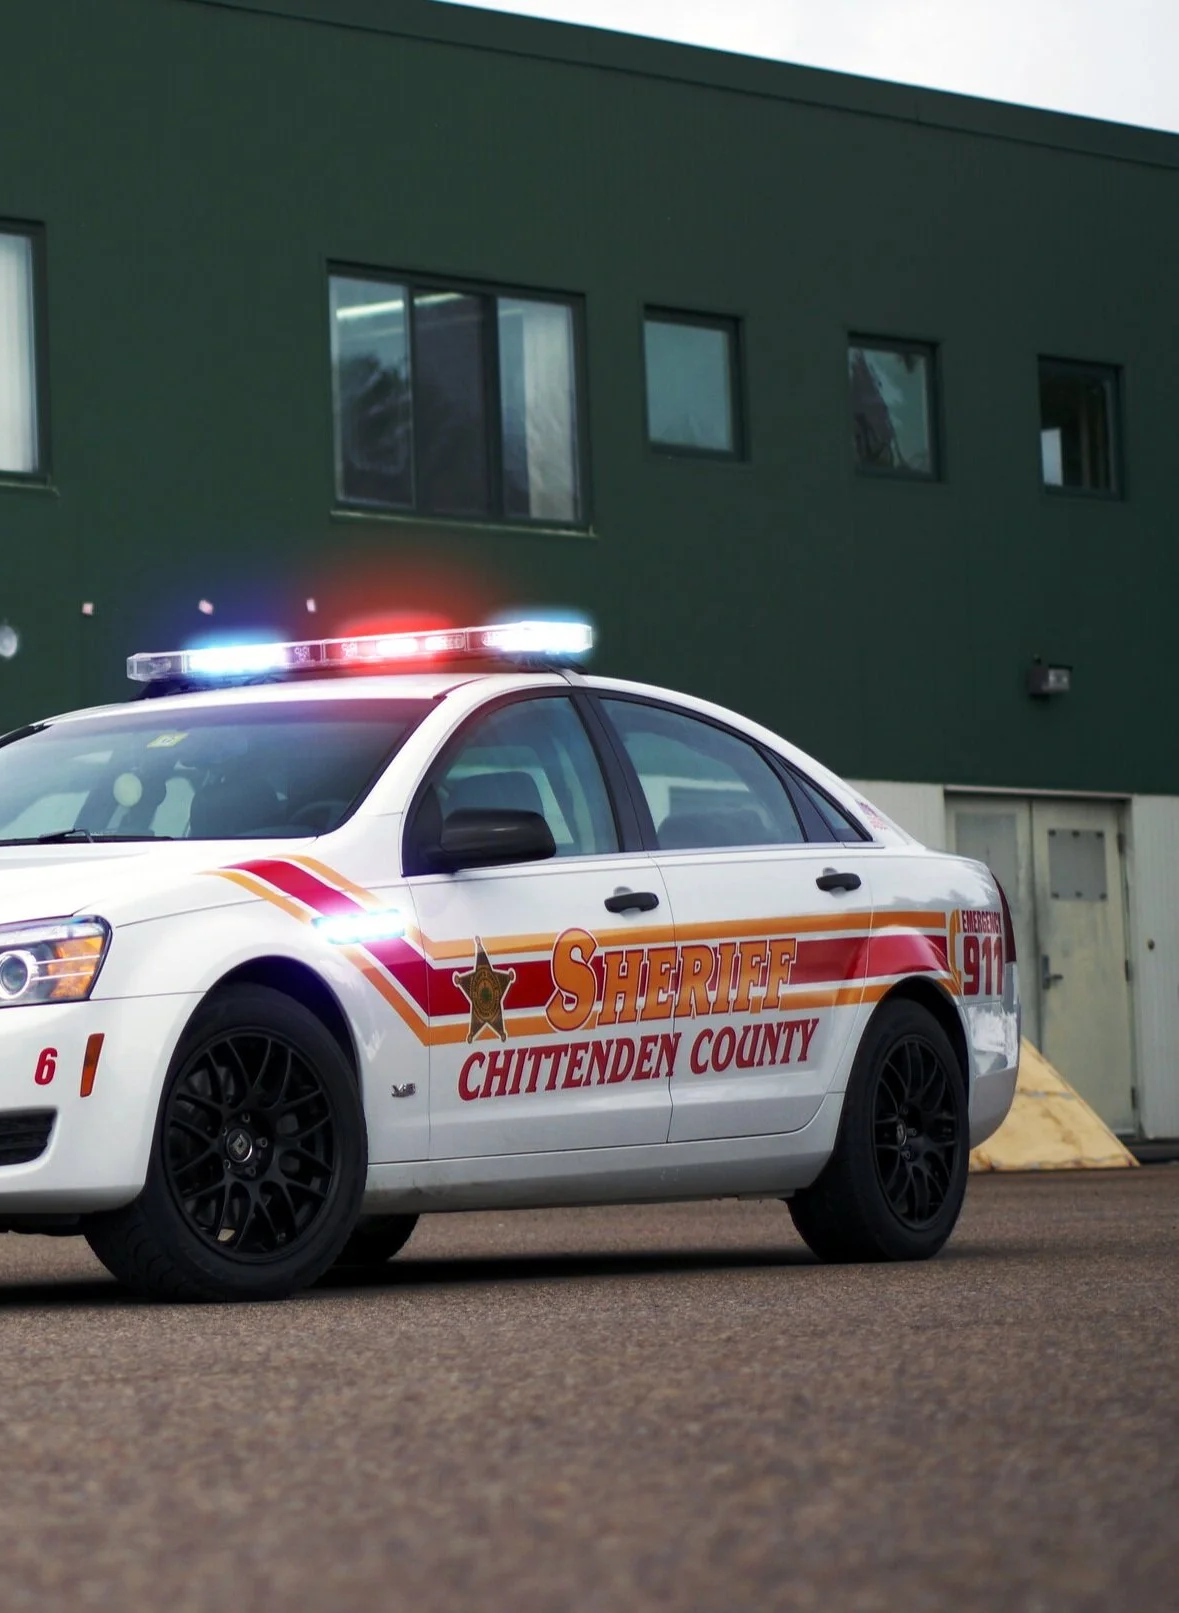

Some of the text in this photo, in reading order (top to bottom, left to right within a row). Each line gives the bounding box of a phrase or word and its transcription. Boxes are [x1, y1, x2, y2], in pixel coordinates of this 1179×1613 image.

[961, 910, 1002, 934] EMERGENCY
[545, 927, 797, 1032] SHERIFF
[963, 935, 1003, 996] 911
[34, 1047, 58, 1085] 6
[458, 1018, 819, 1101] CHITTENDEN COUNTY
